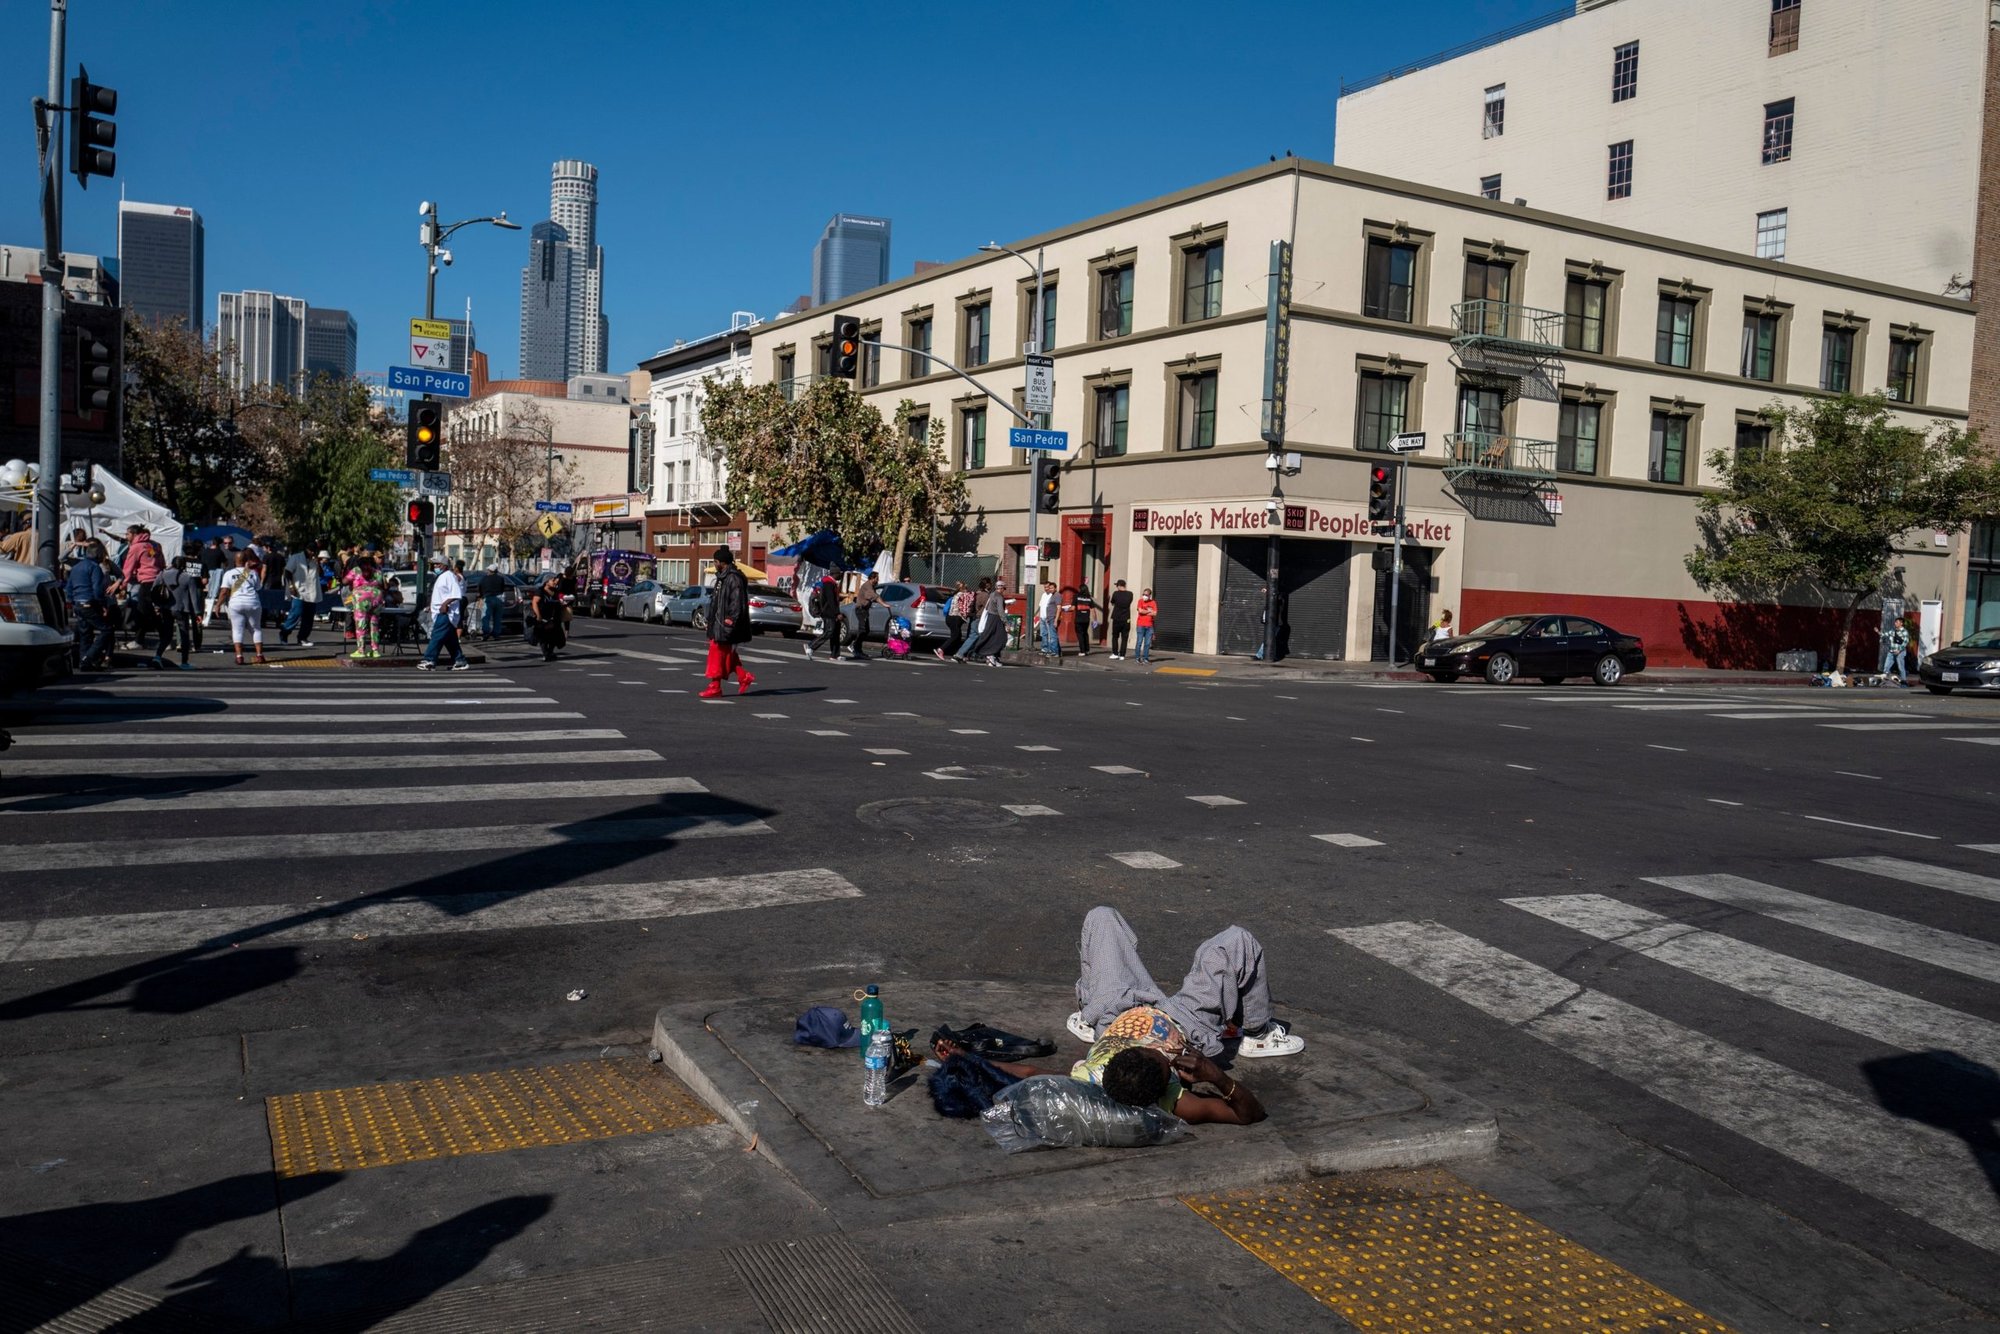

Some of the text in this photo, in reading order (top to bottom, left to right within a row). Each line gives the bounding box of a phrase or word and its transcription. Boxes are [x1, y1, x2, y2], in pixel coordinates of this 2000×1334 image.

[423, 330, 449, 338] VEHICLES
[394, 371, 465, 391] San Pedro
[1033, 378, 1046, 386] BUS
[1014, 432, 1064, 446] San Pedro
[1411, 438, 1422, 446] WAY
[374, 471, 387, 479] San
[388, 471, 407, 480] Pedro
[1135, 511, 1147, 520] SKID
[1287, 508, 1305, 518] SKID
[1135, 520, 1147, 529] ROW
[1151, 507, 1268, 534] People's Market
[1287, 519, 1304, 529] ROW
[1390, 518, 1452, 542] arket
